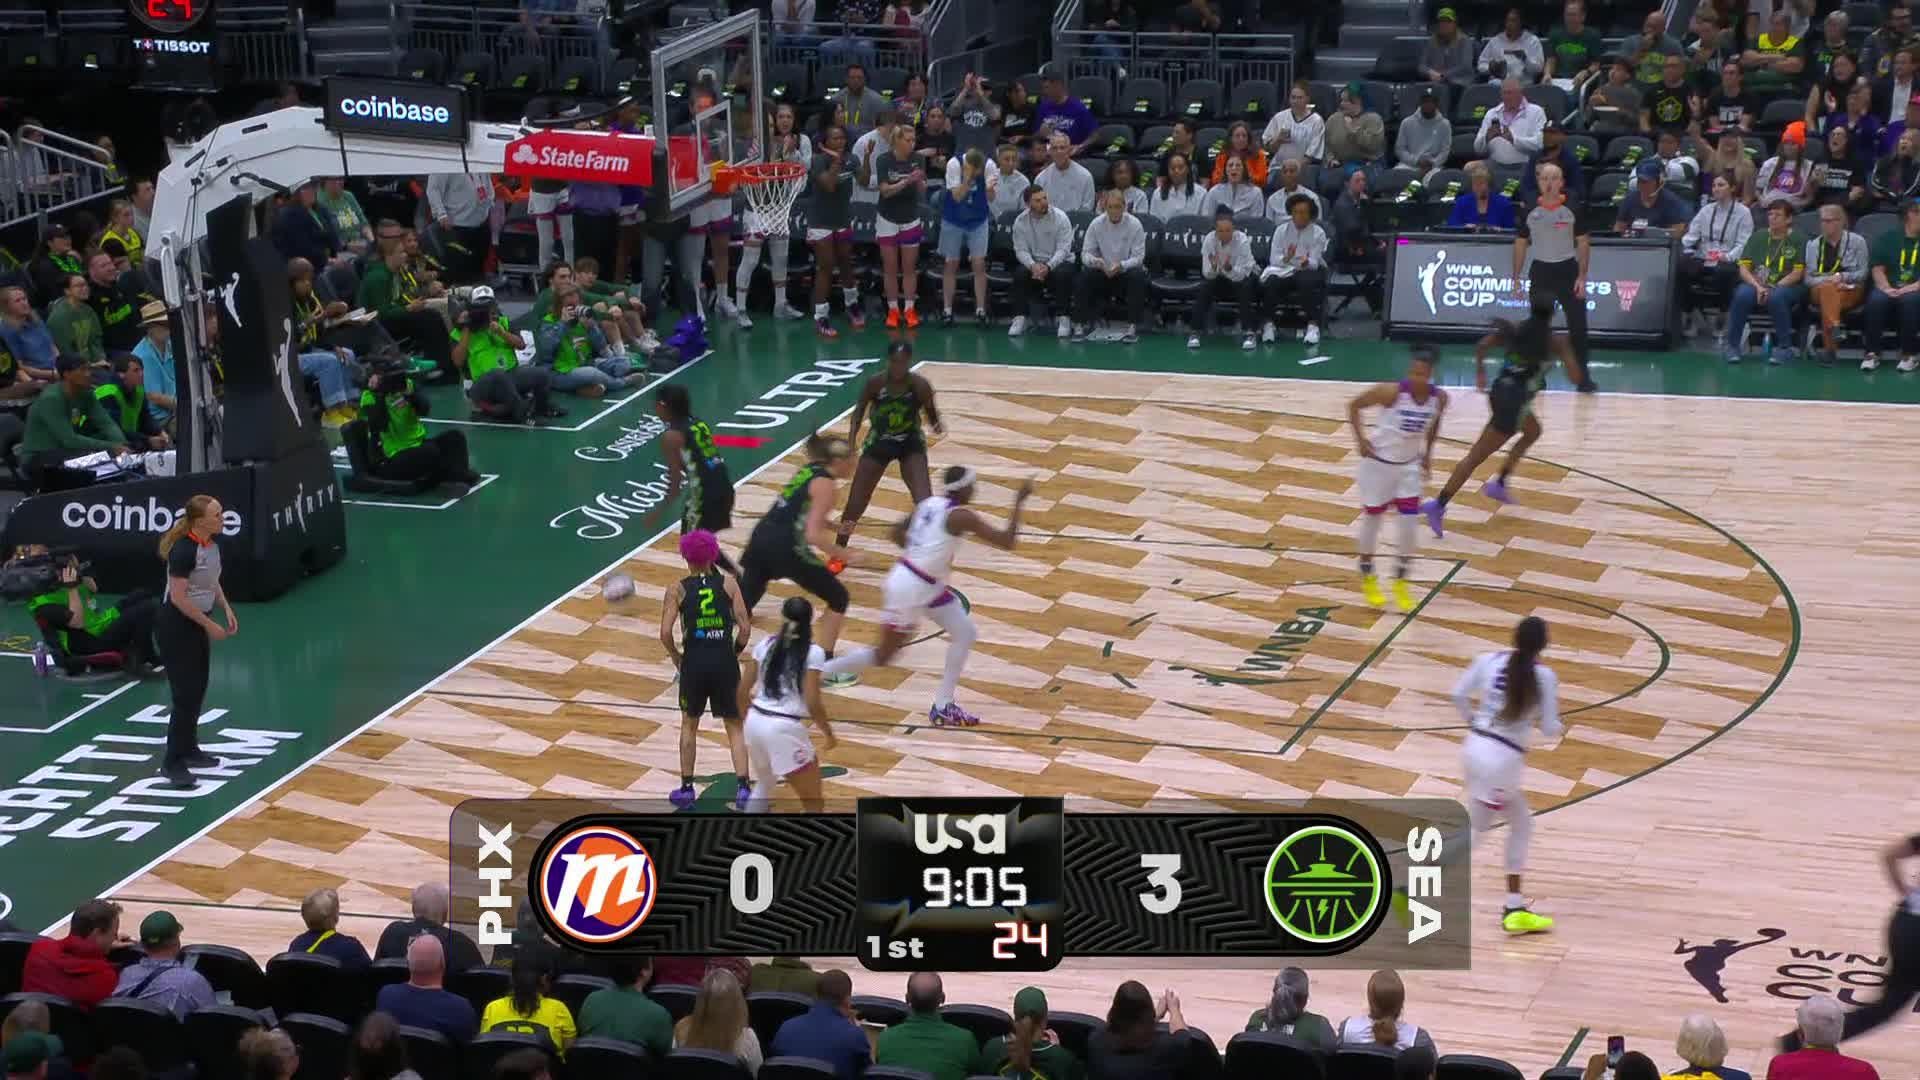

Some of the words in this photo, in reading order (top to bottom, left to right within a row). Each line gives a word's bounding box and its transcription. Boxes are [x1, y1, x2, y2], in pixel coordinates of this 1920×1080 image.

[154, 40, 210, 53] TISSOT
[341, 95, 449, 123] coinbase
[1445, 263, 1494, 275] WNBA
[1442, 291, 1495, 307] CUP
[716, 357, 881, 430] ULTRA
[62, 495, 242, 536] coinbe
[698, 588, 716, 616] 2
[1235, 605, 1343, 672] WNBA
